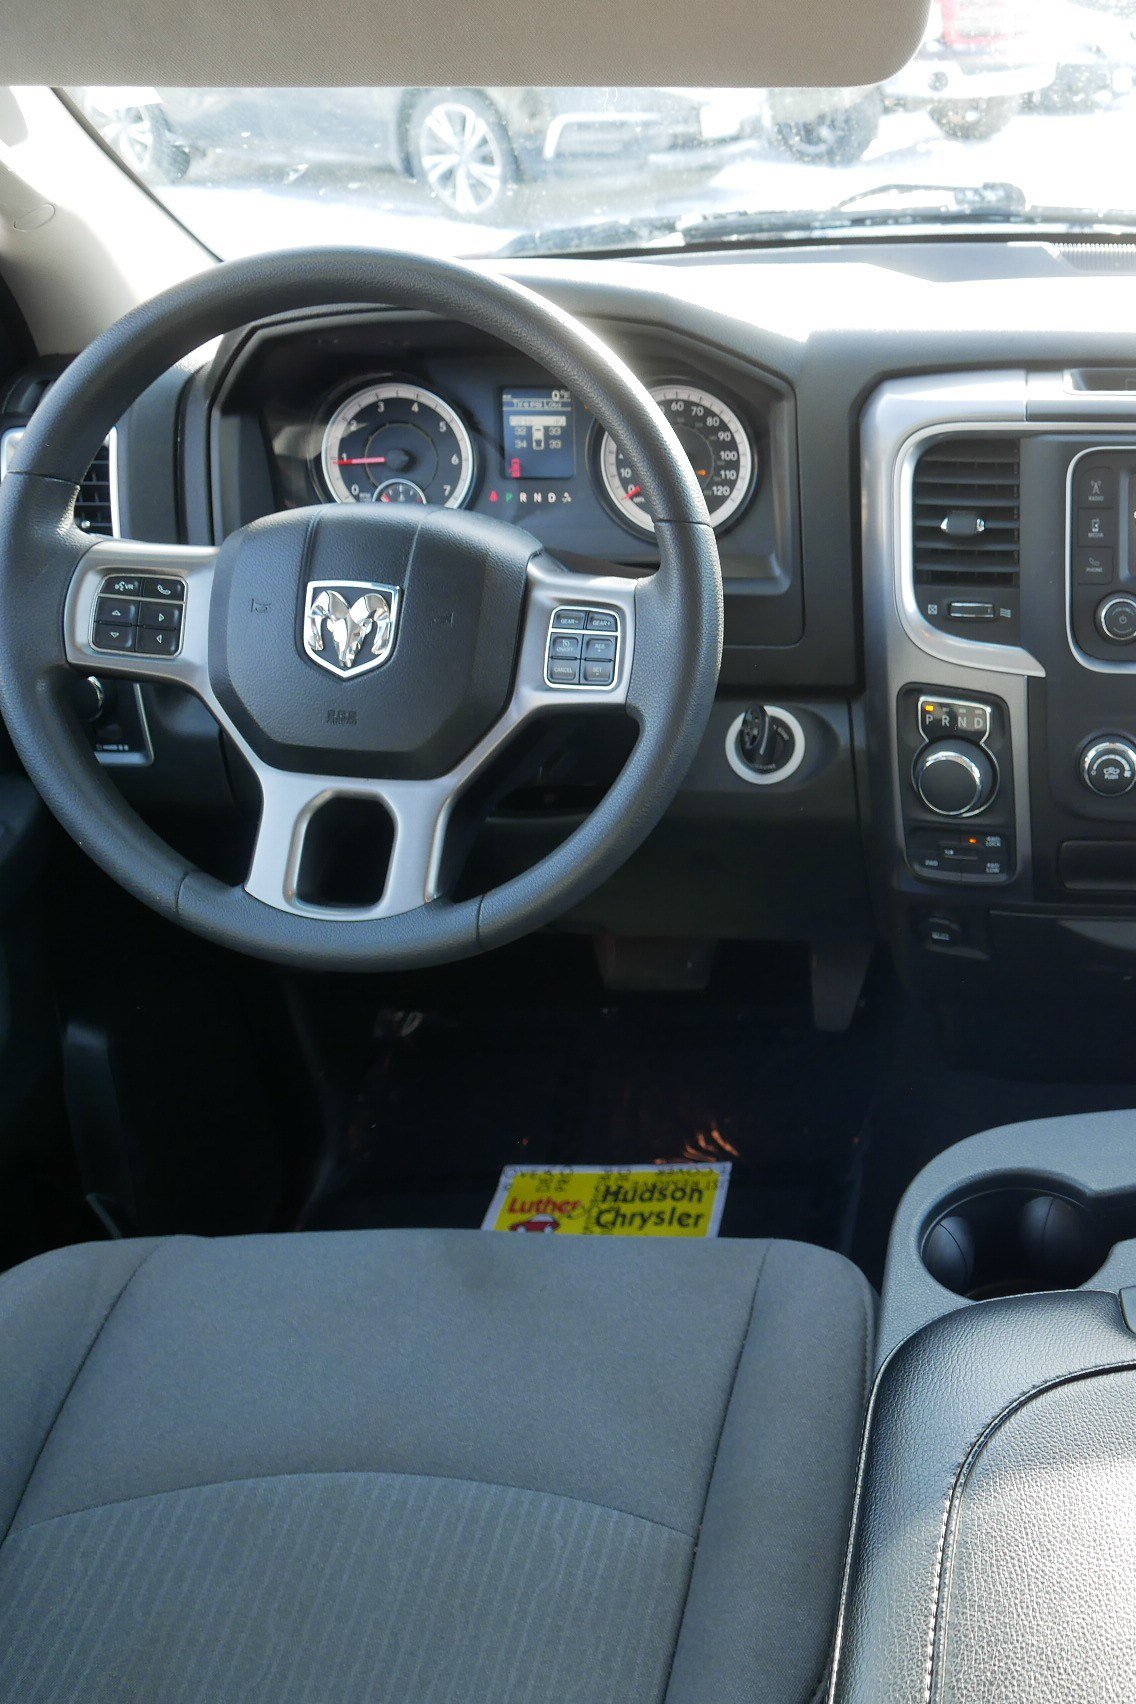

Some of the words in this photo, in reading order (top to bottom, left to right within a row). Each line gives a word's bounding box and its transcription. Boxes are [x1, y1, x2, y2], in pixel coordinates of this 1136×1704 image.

[377, 402, 385, 413] 3
[411, 402, 419, 413] 4
[671, 401, 685, 411] 60
[690, 405, 705, 416] 70
[439, 421, 447, 432] 5
[706, 417, 720, 427] 80
[718, 431, 732, 441] 90
[341, 453, 348, 462] 1
[451, 454, 459, 465] 6
[719, 450, 738, 461] 100
[620, 467, 632, 478] 10
[720, 469, 737, 480] 110
[352, 484, 360, 495] 0
[443, 484, 451, 496] 7
[712, 486, 730, 496] 120
[520, 492, 528, 503] R
[534, 492, 542, 503] N
[548, 492, 556, 503] D
[926, 714, 933, 725] P
[942, 715, 950, 726] R
[958, 716, 967, 727] N
[974, 717, 983, 728] D
[601, 1183, 704, 1204] Hudson
[508, 1196, 582, 1214] Luther
[595, 1206, 704, 1232] Chrysler
